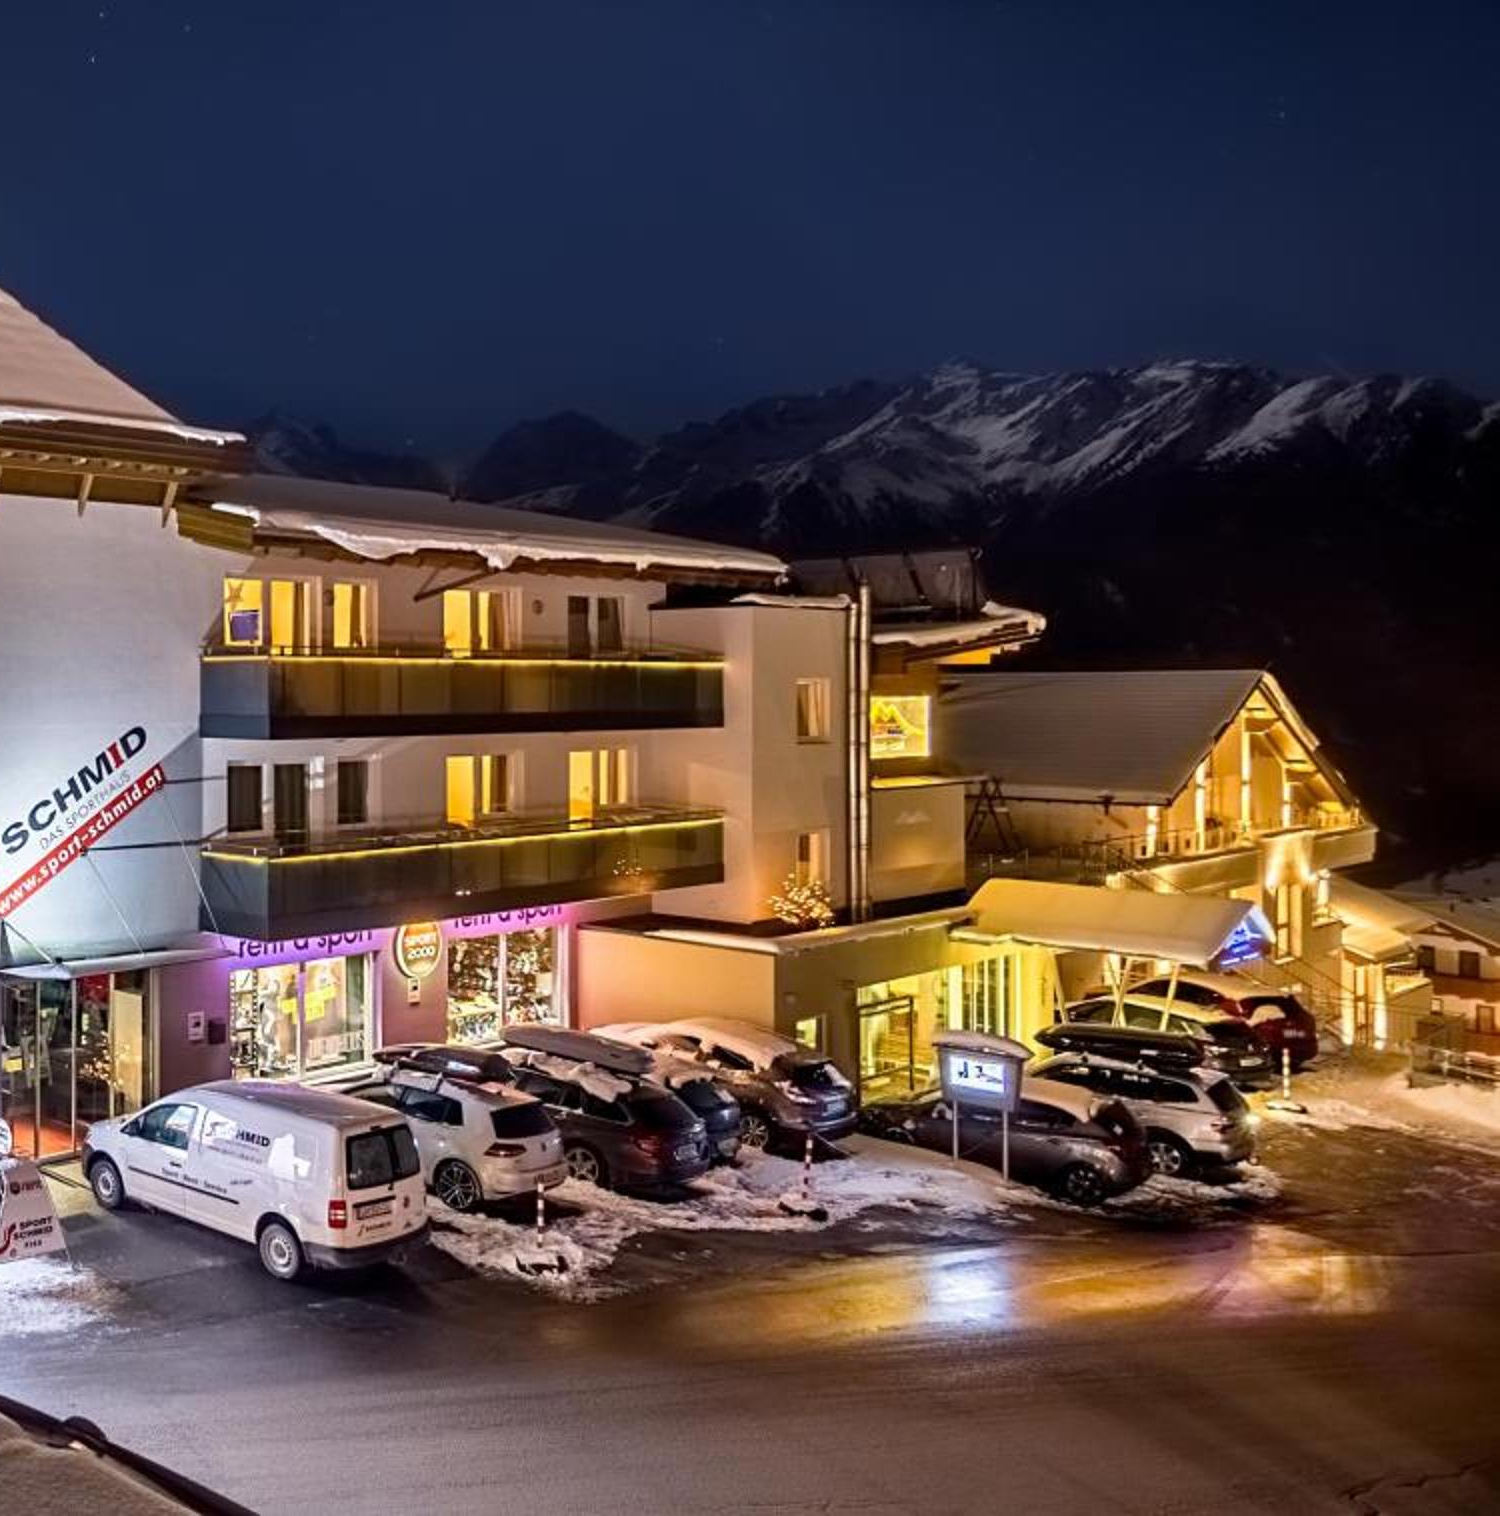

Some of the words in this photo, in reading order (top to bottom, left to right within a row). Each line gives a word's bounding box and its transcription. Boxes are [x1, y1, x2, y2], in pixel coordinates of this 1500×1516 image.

[1, 725, 147, 855] SCHMID
[39, 822, 65, 851] DAS
[66, 769, 132, 829] SPORTHAUS
[13, 1225, 54, 1241] SCHMID
[19, 1215, 53, 1230] SPORT
